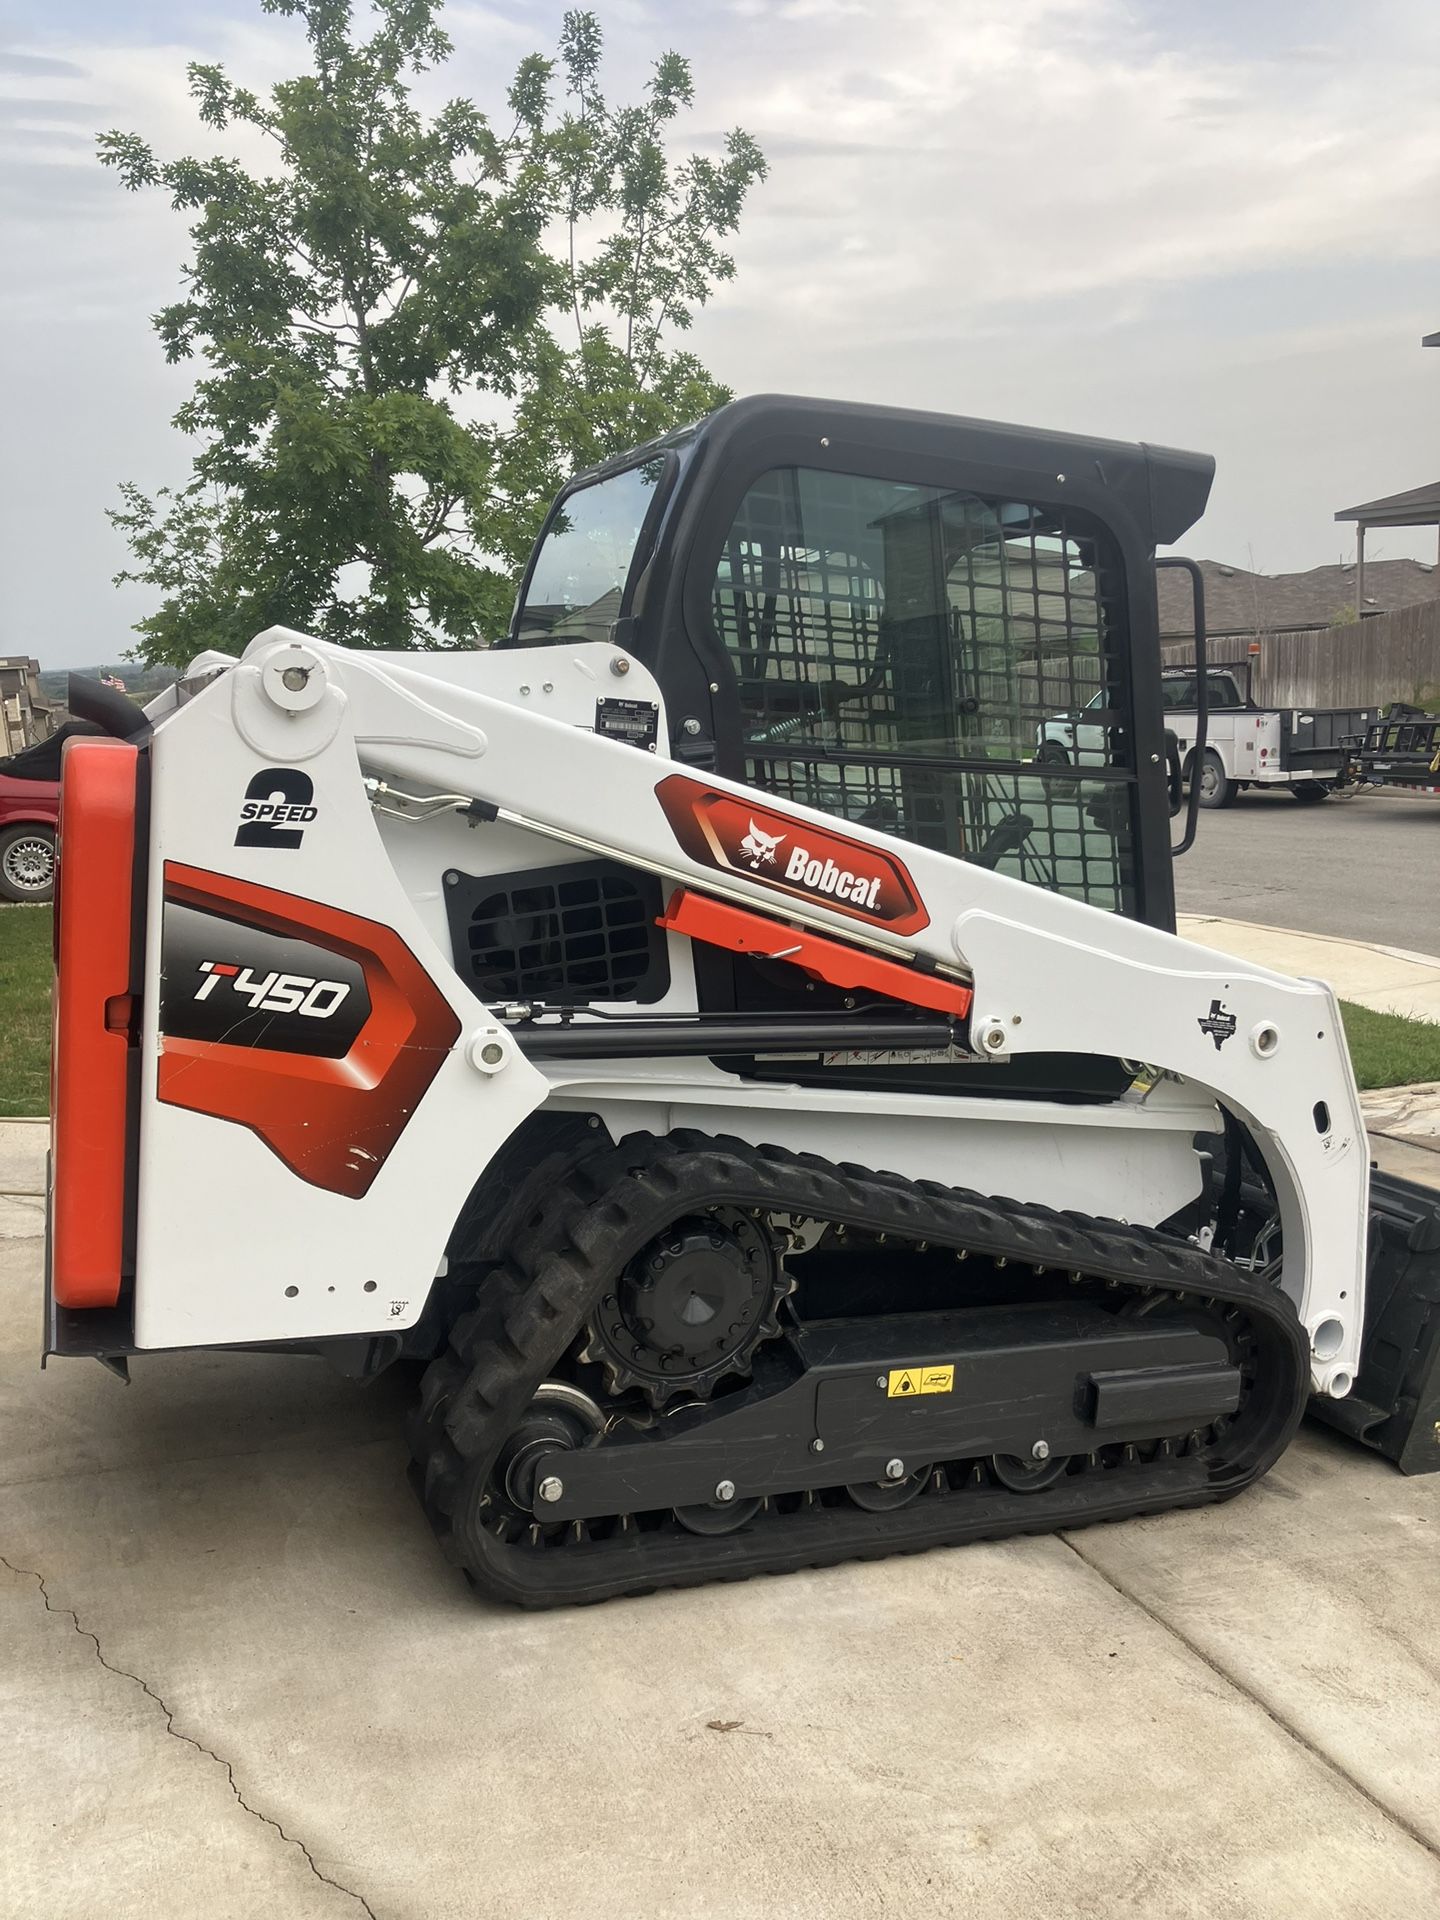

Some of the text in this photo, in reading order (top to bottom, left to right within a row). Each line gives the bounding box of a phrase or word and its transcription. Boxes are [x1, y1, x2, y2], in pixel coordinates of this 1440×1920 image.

[233, 767, 318, 849] 2 SPEED
[784, 846, 881, 909] Bobcat
[194, 961, 350, 1018] T450
